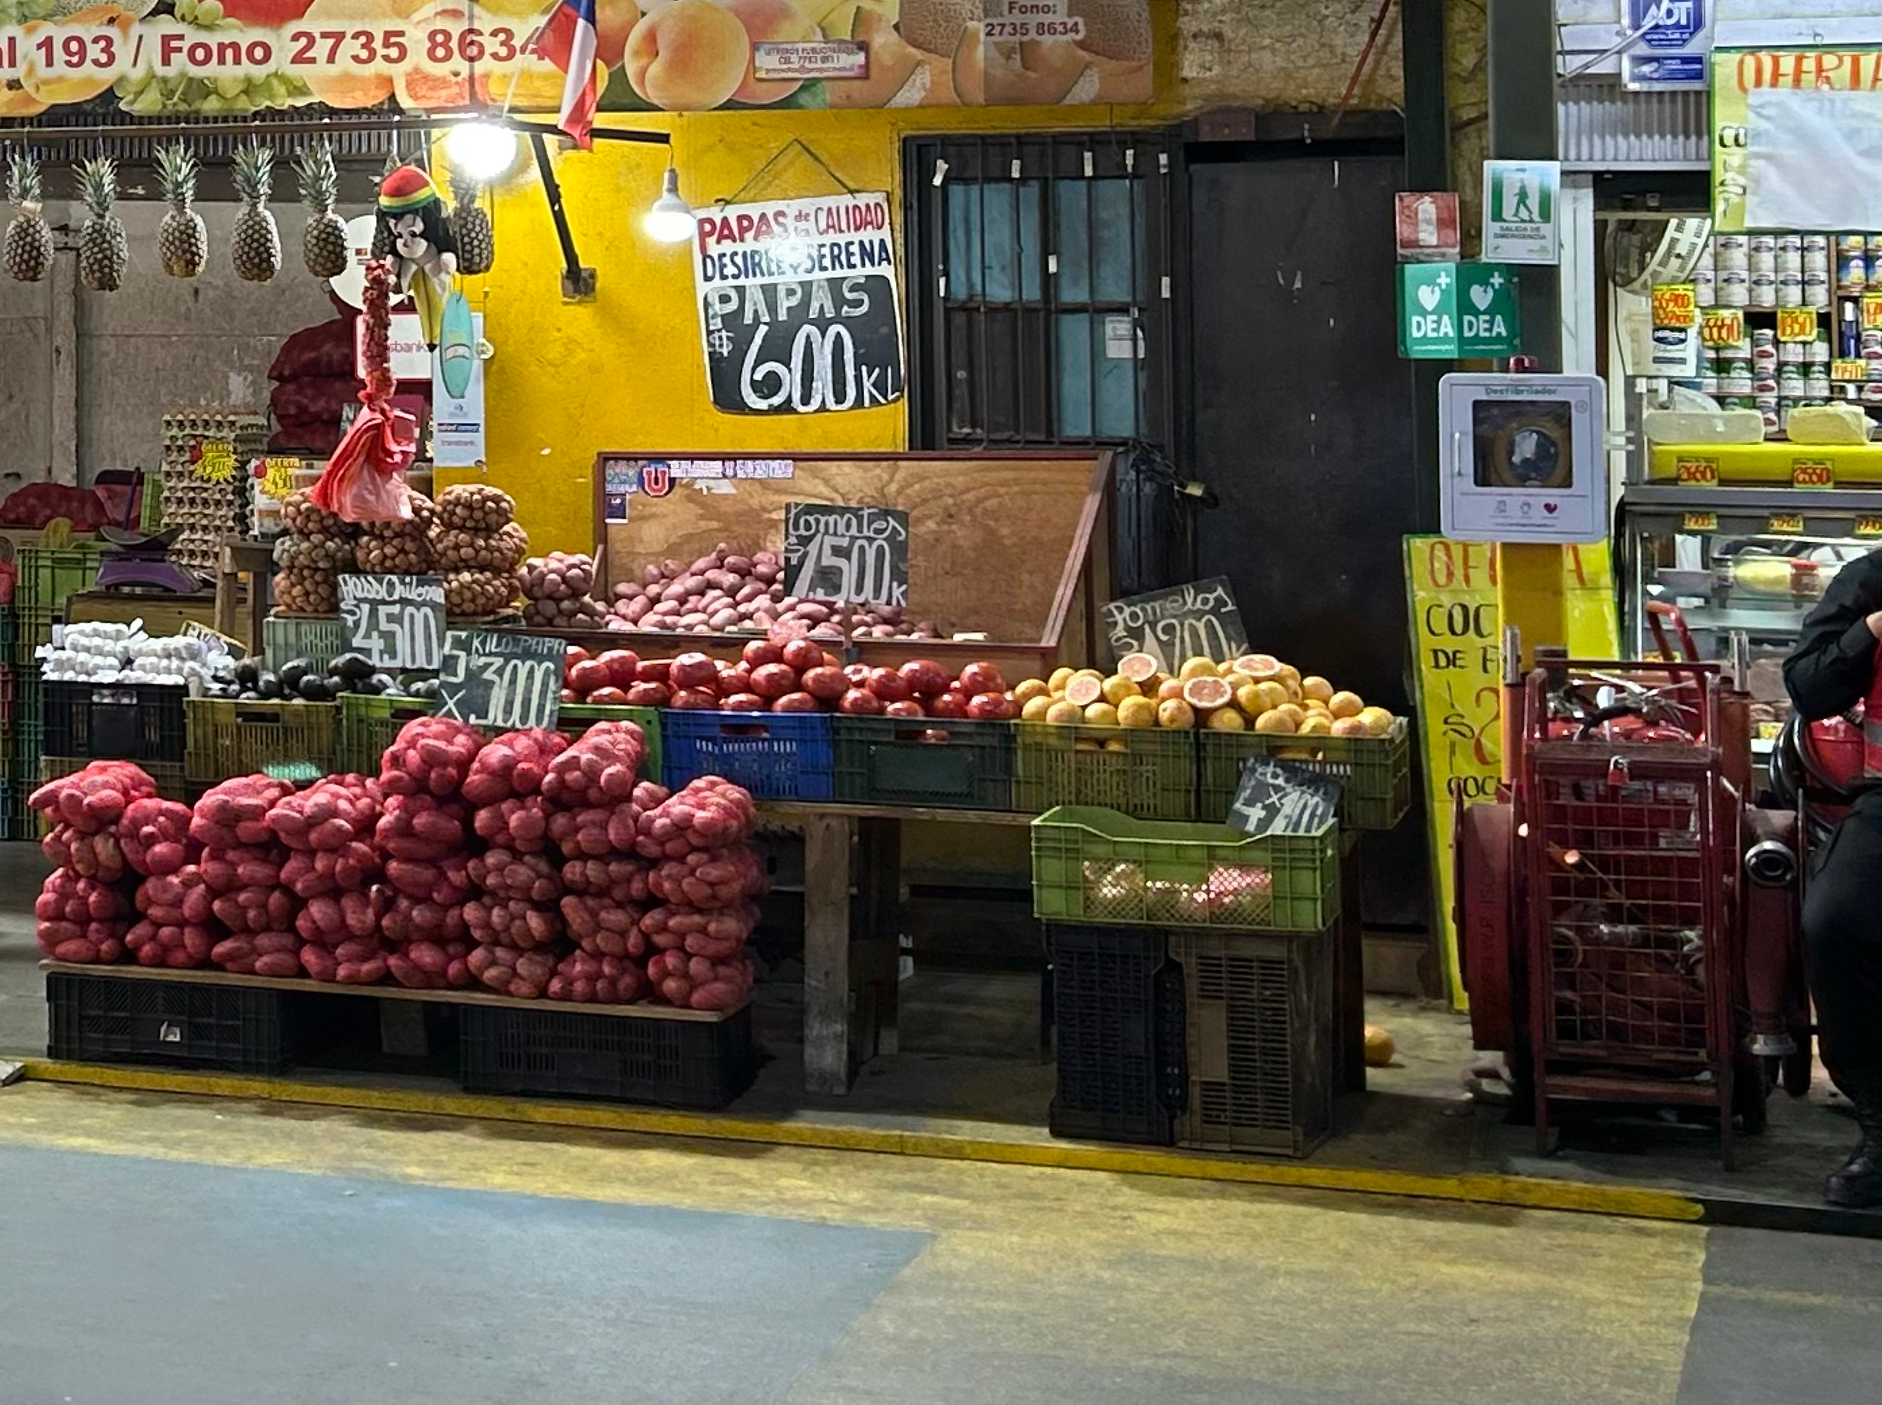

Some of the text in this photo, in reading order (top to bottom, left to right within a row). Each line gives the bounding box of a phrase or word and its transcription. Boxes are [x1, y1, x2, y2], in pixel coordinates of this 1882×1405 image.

[1008, 0, 1057, 15] Fono:
[985, 21, 1080, 37] 2735 8634
[35, 34, 117, 68] 193
[160, 34, 273, 67] Fono
[289, 29, 408, 65] 2735
[426, 26, 548, 63] 8634
[697, 210, 789, 257] PAPAS
[814, 201, 885, 237] CALIDAD
[706, 276, 870, 330] PAPAS
[1411, 314, 1455, 338] DEA
[1463, 314, 1507, 338] DEA
[706, 323, 857, 412] $600
[1426, 603, 1498, 638] COC
